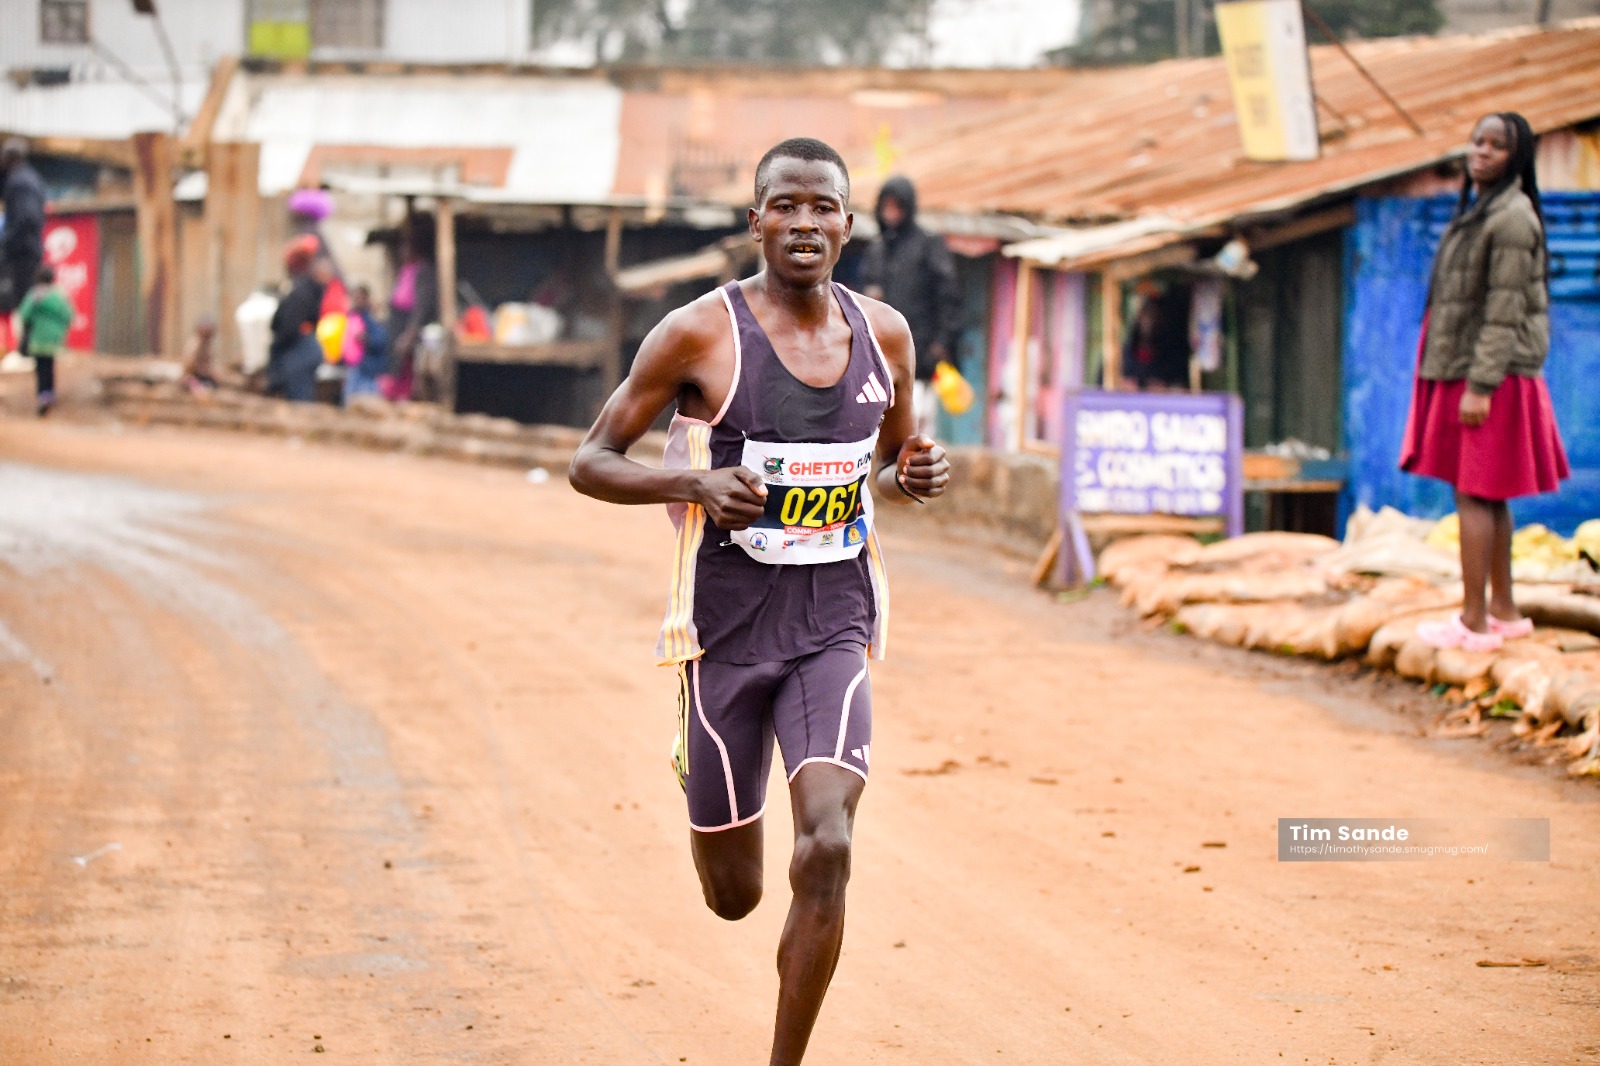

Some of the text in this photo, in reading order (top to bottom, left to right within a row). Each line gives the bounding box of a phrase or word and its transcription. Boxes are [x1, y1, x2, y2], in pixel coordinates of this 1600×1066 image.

[1151, 412, 1227, 453] SALON
[789, 461, 854, 475] GHETTO
[1097, 451, 1226, 491] COSMETICS
[780, 481, 859, 527] 0267
